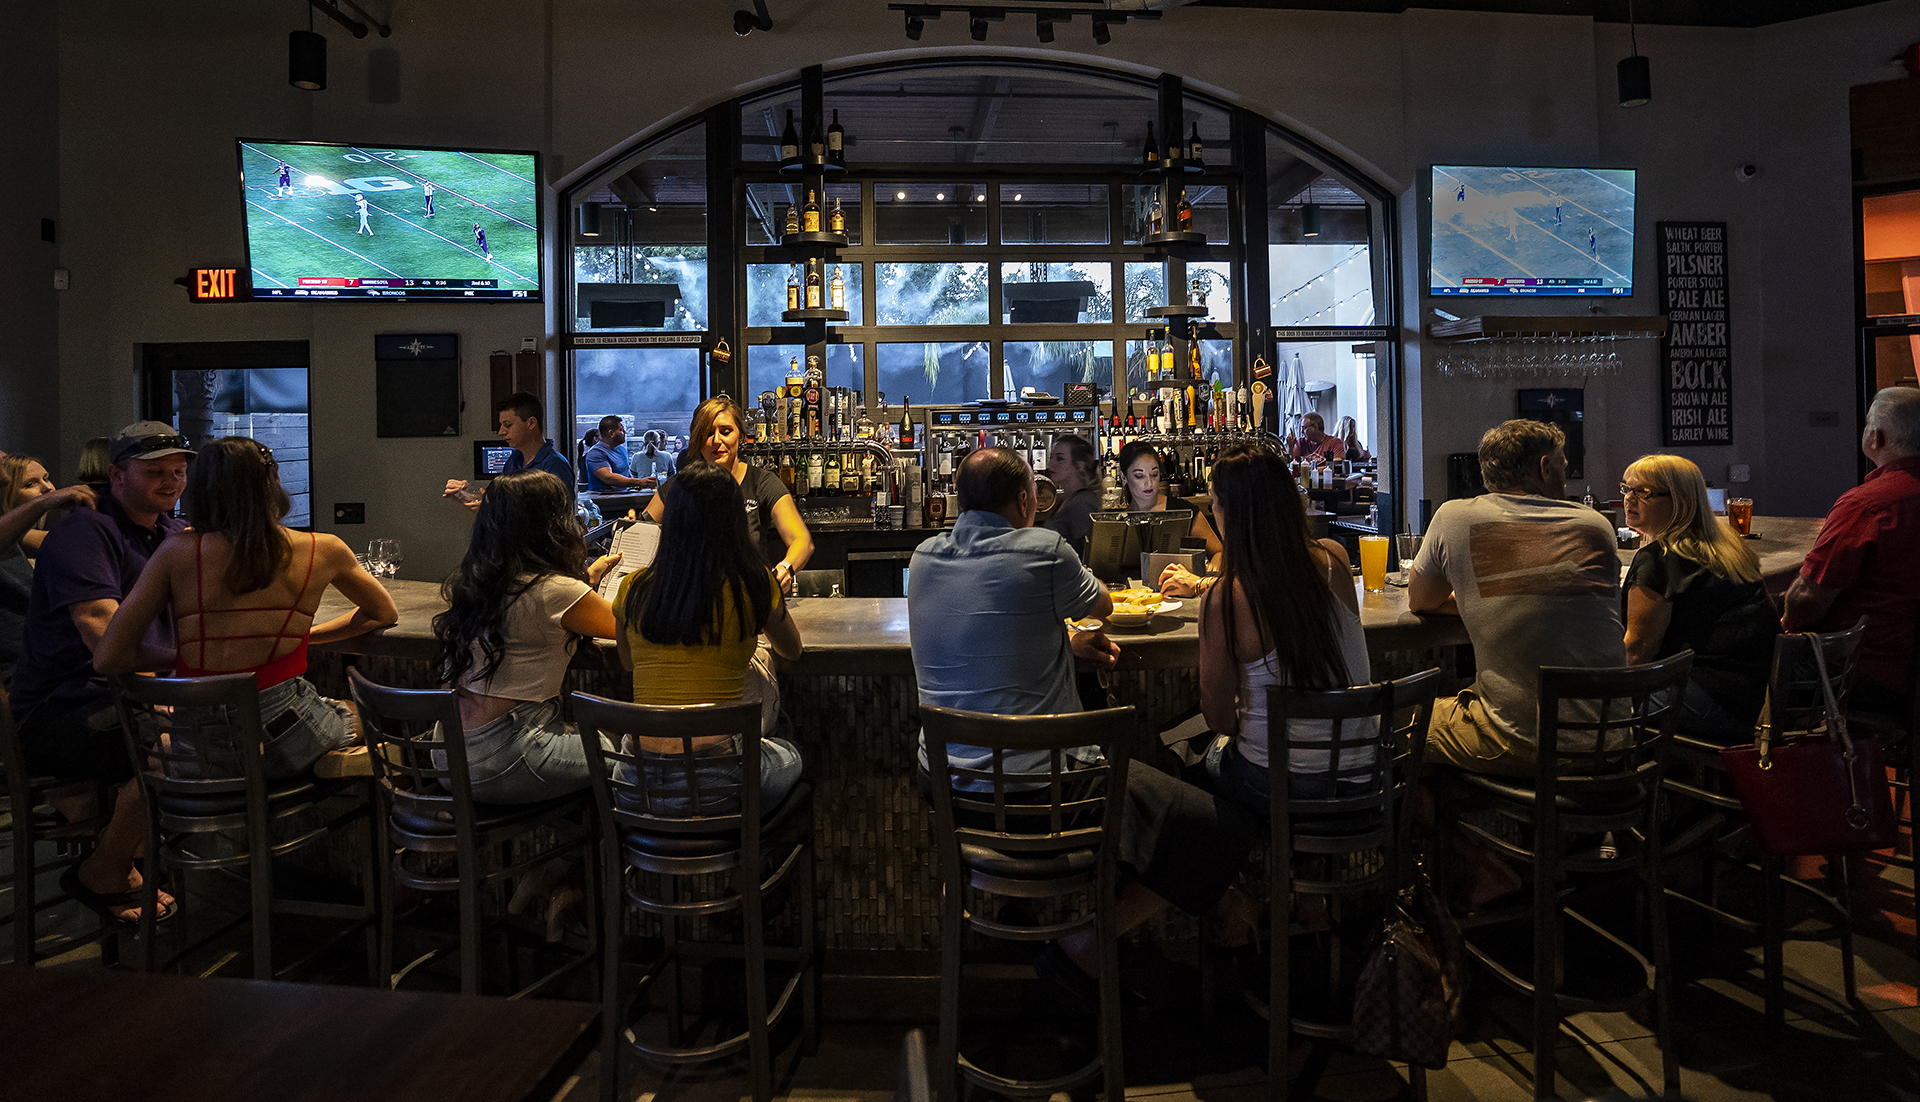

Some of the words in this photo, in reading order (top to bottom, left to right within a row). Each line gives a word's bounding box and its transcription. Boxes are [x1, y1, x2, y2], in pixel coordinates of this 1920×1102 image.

[1664, 226, 1698, 240] WHEAT
[1700, 227, 1722, 240] BEER
[1666, 242, 1693, 254] BALTIC
[1694, 241, 1723, 253] PORTER
[1667, 254, 1724, 275] PILSNER
[196, 268, 236, 298] EXIT
[1668, 276, 1698, 289] PORTER
[1699, 276, 1724, 288] STOUT
[1668, 290, 1700, 308] PALE
[1702, 290, 1725, 308] ALE
[1669, 310, 1700, 322] GERMAN
[1702, 310, 1725, 321] LAGER
[1670, 322, 1726, 346] AMBER
[1670, 348, 1704, 359] AMERICAN
[1706, 347, 1728, 358] LAGER
[1671, 359, 1728, 390] BOCK
[1671, 392, 1708, 406] BROWN
[1710, 391, 1728, 406] ALE
[1671, 408, 1702, 426] IRISH
[1706, 408, 1728, 426] ALE
[1672, 427, 1704, 441] BARLEY
[1706, 427, 1730, 441] WINE
